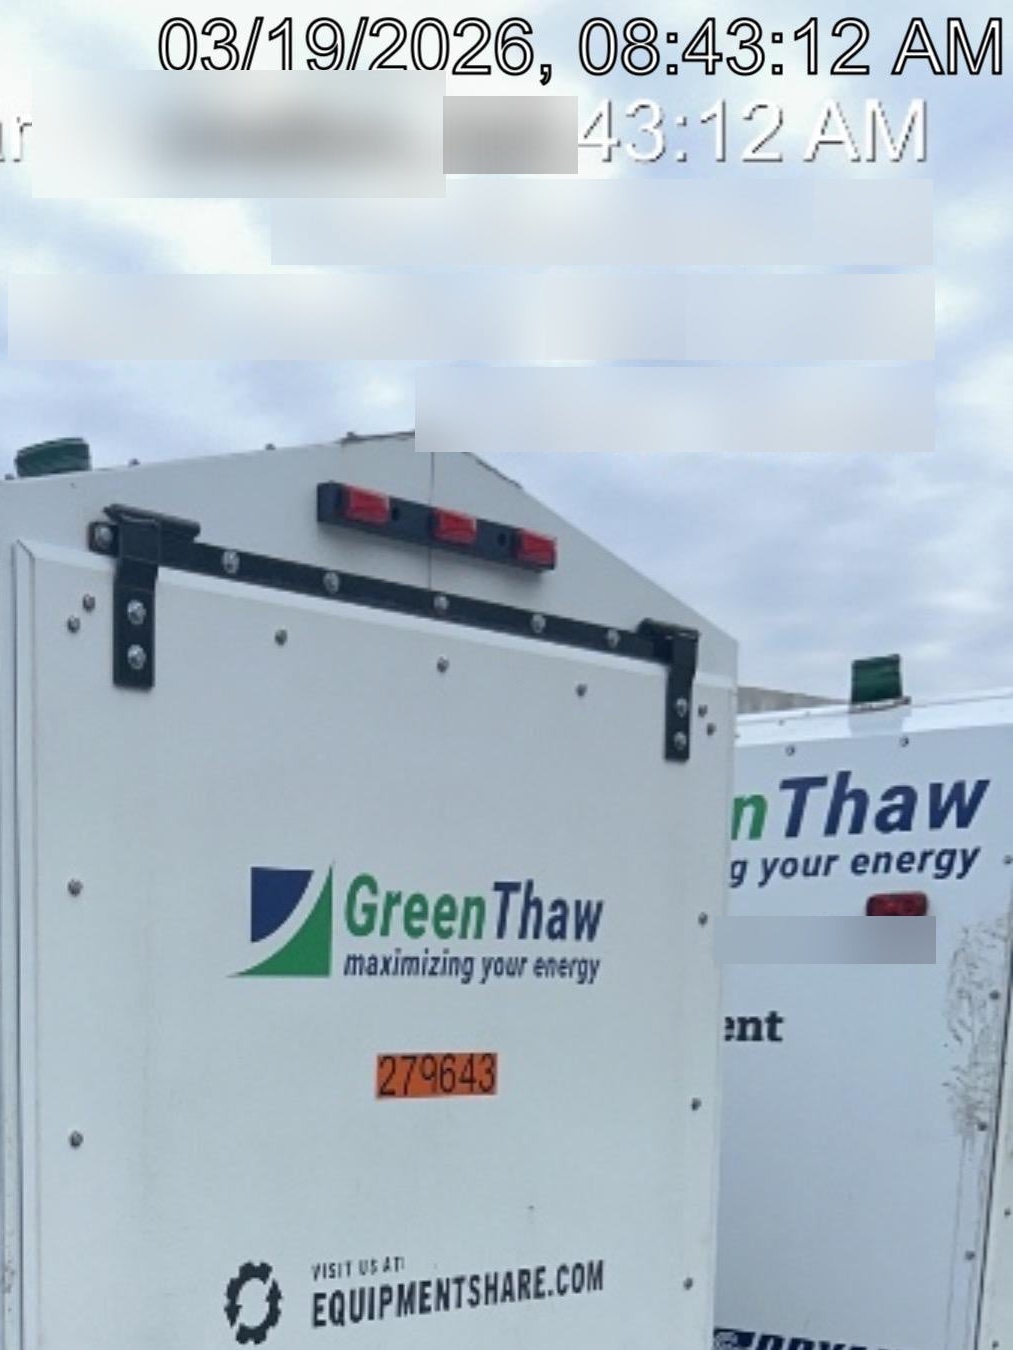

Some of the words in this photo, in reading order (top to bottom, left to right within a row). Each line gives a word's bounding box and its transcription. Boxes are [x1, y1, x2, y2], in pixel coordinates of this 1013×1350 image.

[758, 854, 840, 888] your
[850, 846, 982, 880] energy
[343, 947, 475, 985] maximizing
[480, 955, 528, 985] your
[533, 957, 600, 985] energy
[379, 1053, 496, 1096] 279643
[313, 1259, 352, 1281] VISIT
[358, 1258, 378, 1276] US
[313, 1260, 604, 1328] EQUIPMENTSHARE.COM
